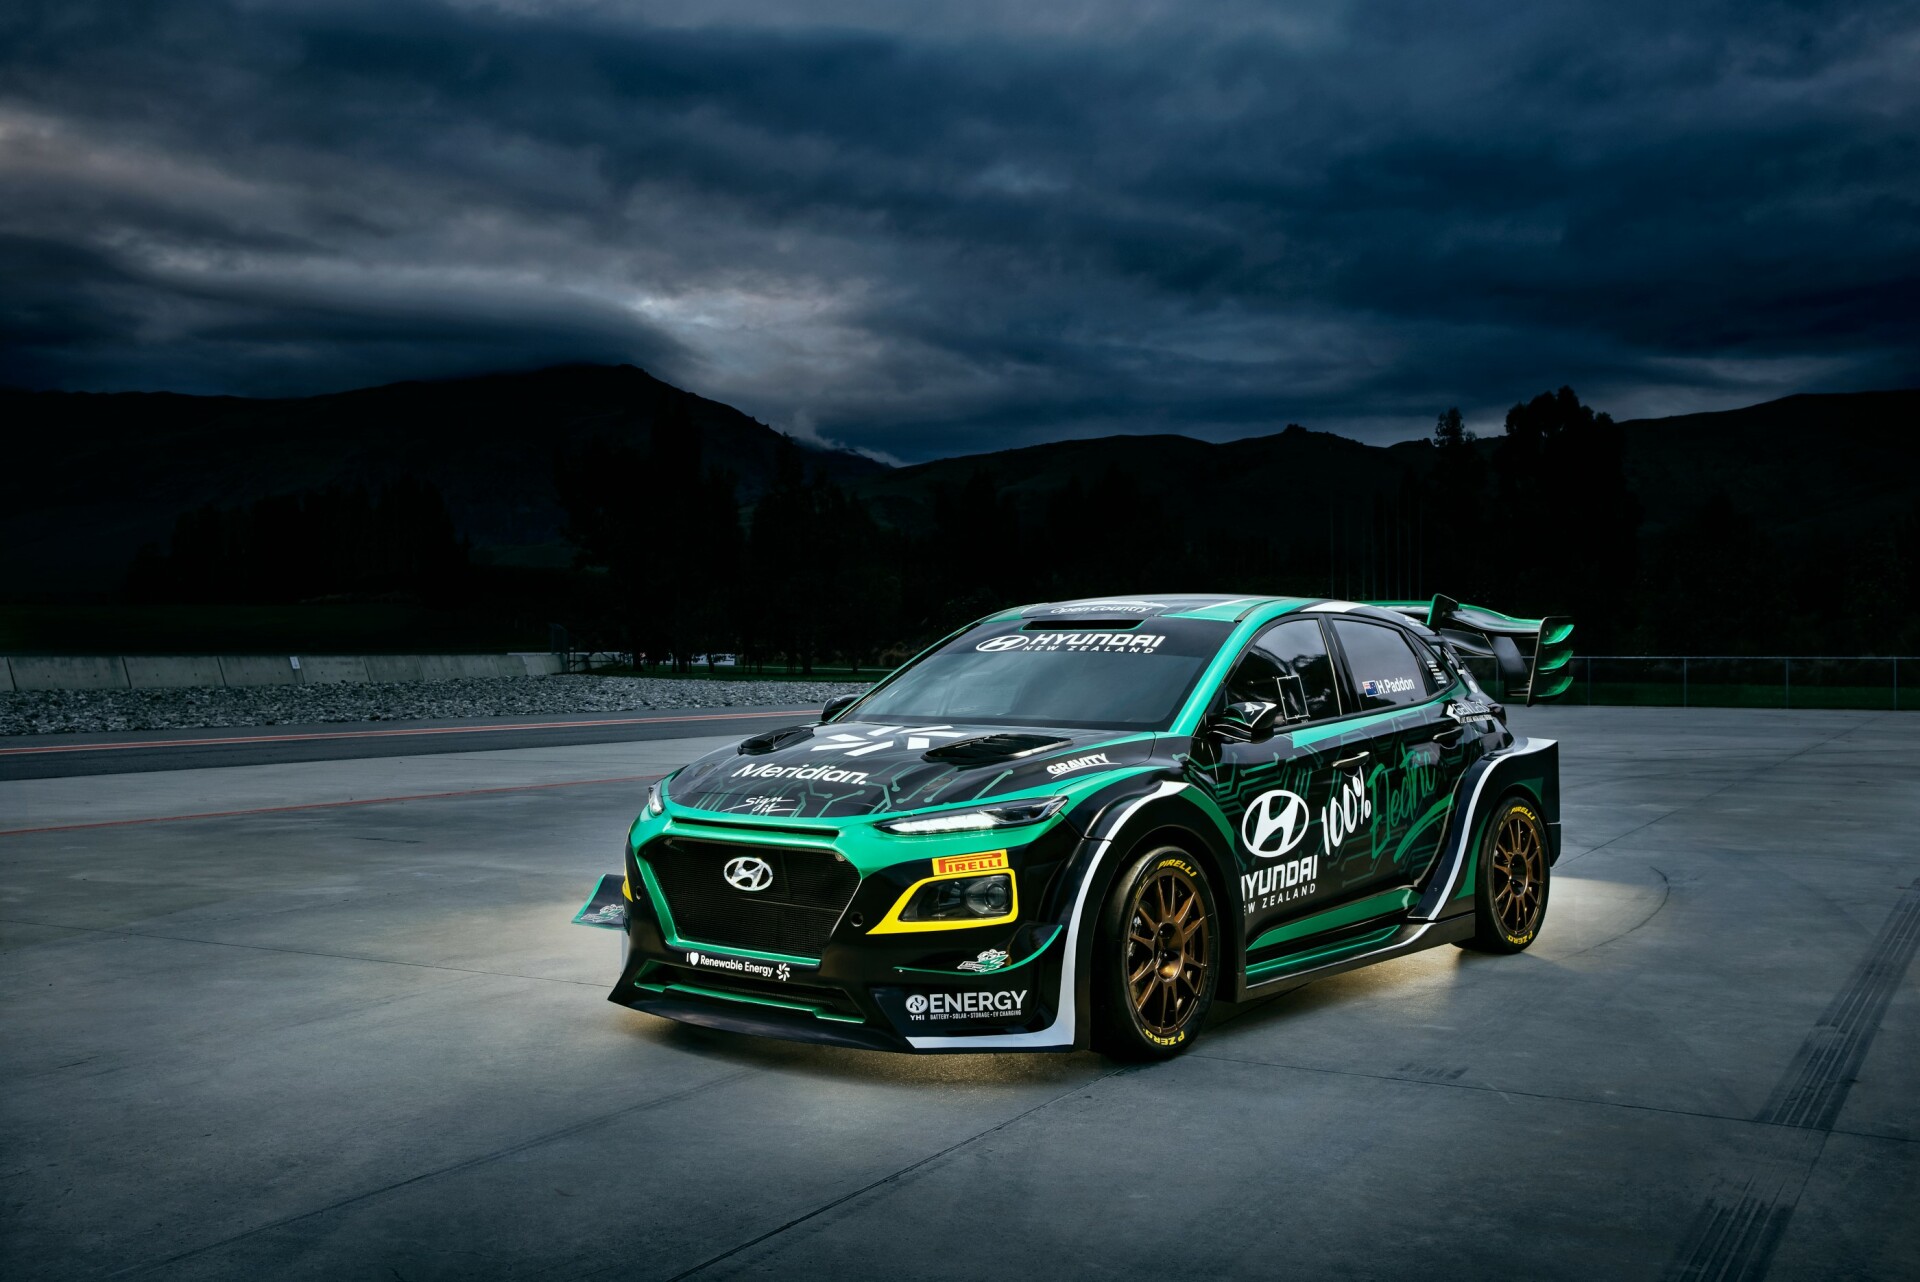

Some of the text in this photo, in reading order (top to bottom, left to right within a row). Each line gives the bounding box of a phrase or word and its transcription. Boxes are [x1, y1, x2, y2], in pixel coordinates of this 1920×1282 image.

[1050, 605, 1153, 614] Open Country
[1029, 633, 1166, 648] HYUNDAI
[1067, 645, 1155, 654] ZEALAND
[1376, 676, 1416, 695] H.Paddon
[1046, 752, 1110, 776] GRAVITY
[1321, 765, 1371, 856] 100%
[1510, 806, 1536, 821] PIRELLI
[938, 852, 1002, 873] PIRELLI
[1157, 858, 1198, 877] PIRELLI
[1262, 883, 1316, 909] ZEALAND
[686, 952, 774, 977] I Renewable Energy
[929, 989, 1028, 1014] ENERGY
[1146, 1029, 1185, 1046] P ZERO
